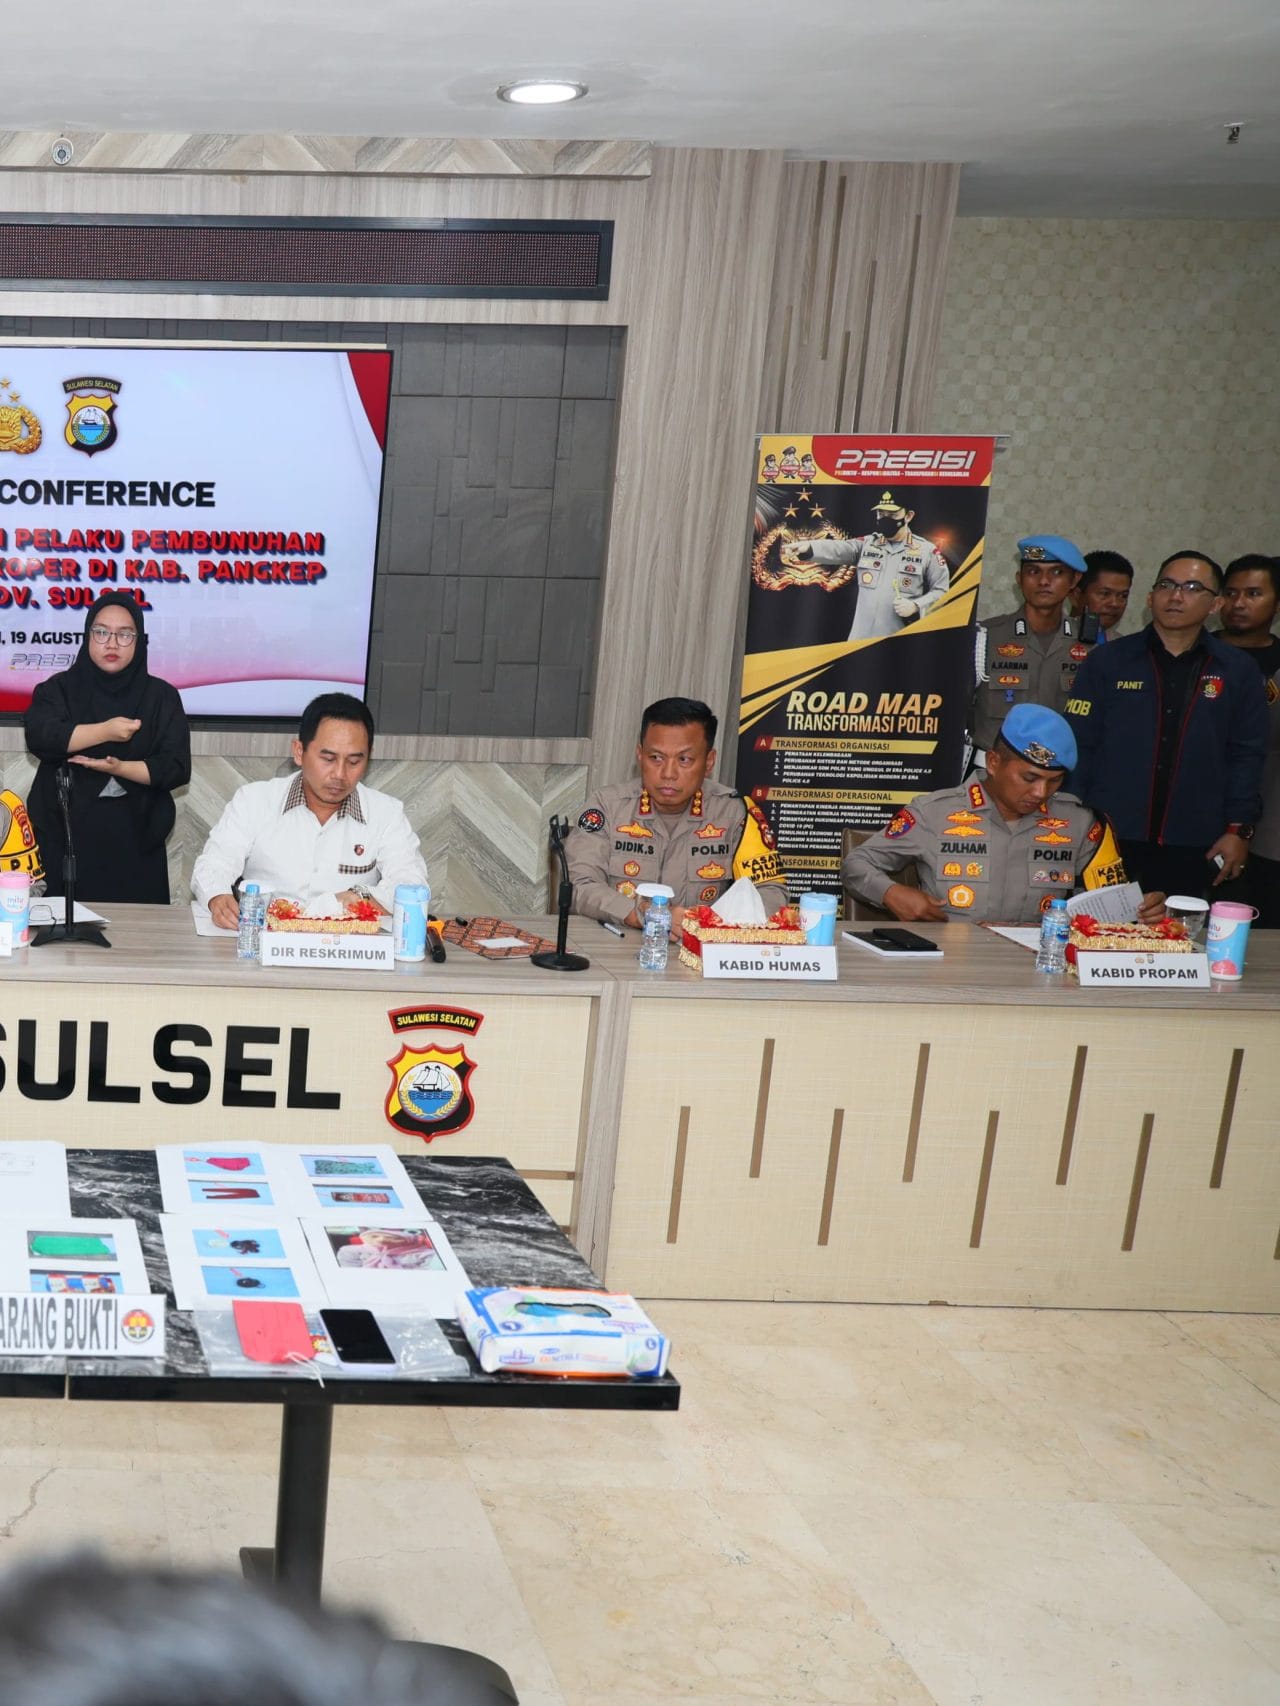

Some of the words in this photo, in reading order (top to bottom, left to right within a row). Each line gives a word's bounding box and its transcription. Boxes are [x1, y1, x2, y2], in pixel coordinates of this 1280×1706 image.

[835, 450, 977, 470] PRESISI
[15, 528, 122, 553] PELAKU
[132, 530, 324, 555] PEMBUNUHAN
[89, 558, 117, 582] DI
[125, 559, 188, 583] KAB.
[198, 559, 326, 584] PANGKEP
[48, 587, 152, 611] SULL
[11, 631, 27, 644] 19
[31, 632, 86, 645] AGUST
[1117, 681, 1144, 690] PANIT
[786, 690, 869, 714] ROAD
[876, 693, 943, 716] MAP
[786, 713, 894, 733] TRANSFORMASI
[897, 716, 939, 734] POLRI
[759, 739, 767, 747] A
[775, 740, 837, 750] TRANSFORMASI
[840, 741, 890, 751] ORGANISASI
[772, 790, 834, 799] TRANSFORMASI
[836, 790, 893, 801] OPERASIONAL
[615, 841, 654, 855] DIDIK.S
[691, 844, 729, 857] POLRI
[940, 842, 987, 855] ZULHAM
[1033, 849, 1072, 861] POLRI
[782, 858, 828, 867] NSFORMASI
[271, 946, 296, 958] DIR
[299, 947, 386, 961] RESKRIMUM
[719, 960, 764, 972] KABID
[768, 960, 821, 973] HUMAS
[1091, 967, 1137, 979] KABID
[1139, 968, 1198, 980] PROPAM
[397, 1013, 438, 1026] SULAWESI
[439, 1013, 476, 1028] SELATAN
[65, 1298, 118, 1350] BUKTI
